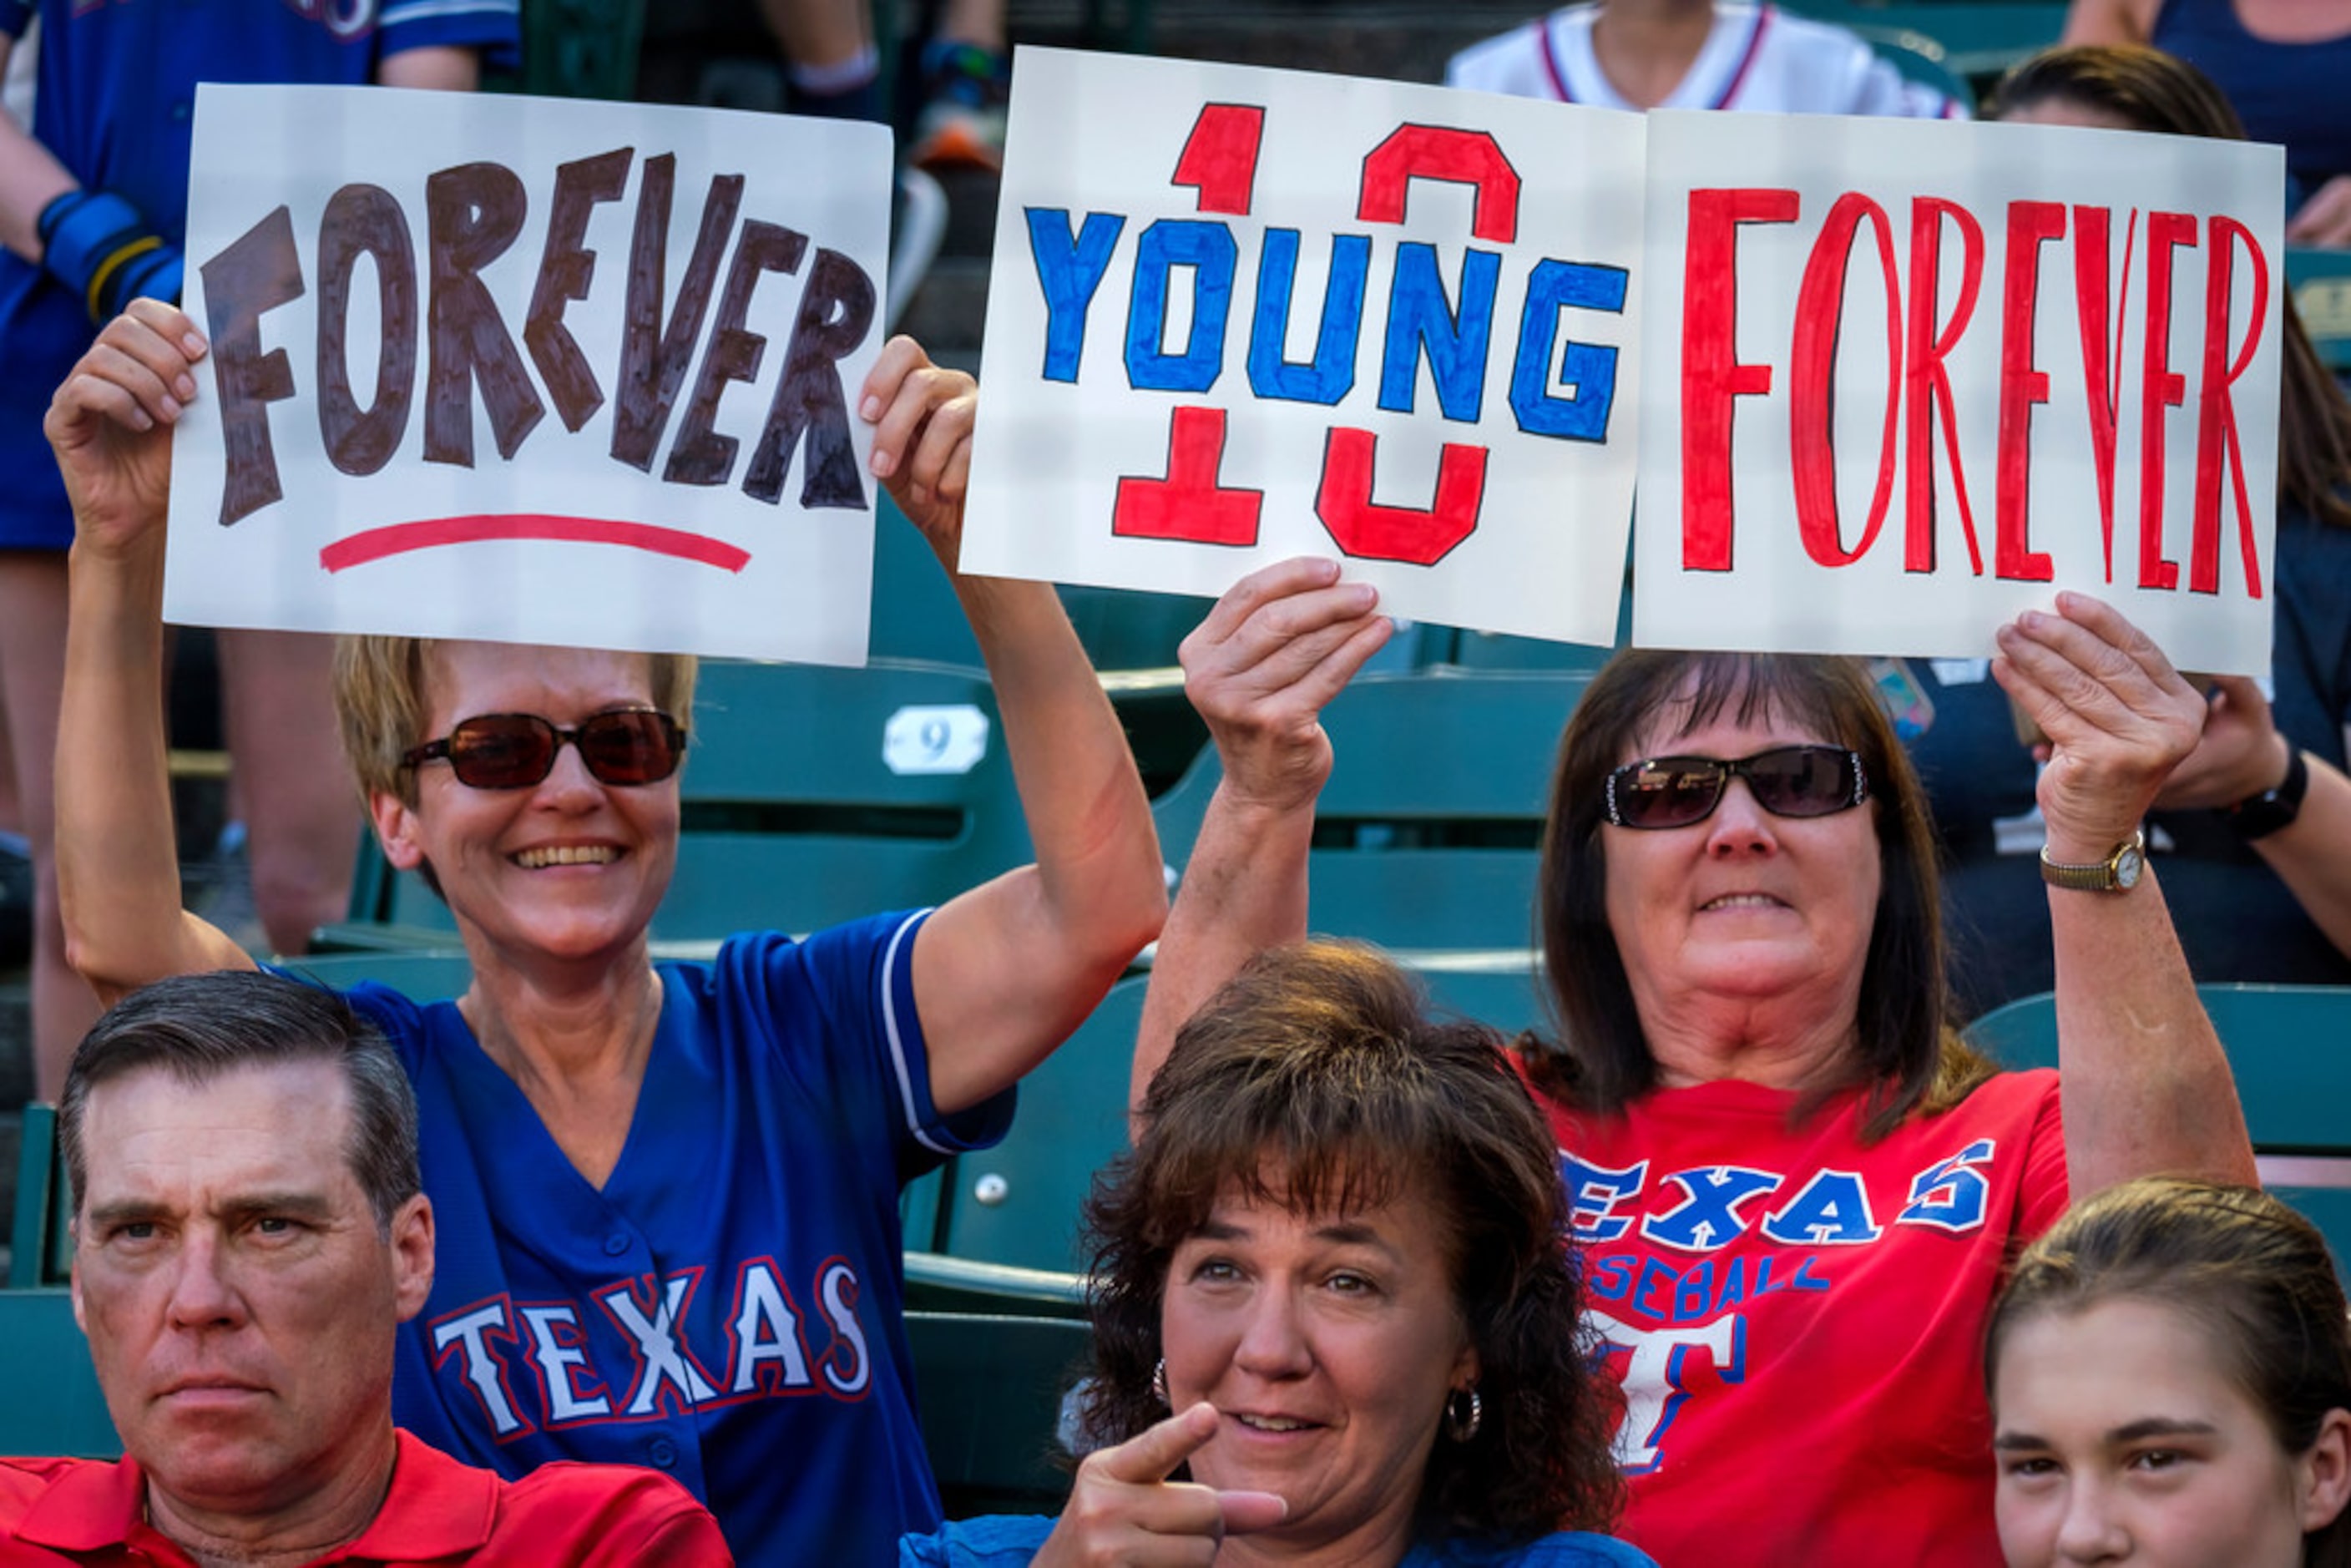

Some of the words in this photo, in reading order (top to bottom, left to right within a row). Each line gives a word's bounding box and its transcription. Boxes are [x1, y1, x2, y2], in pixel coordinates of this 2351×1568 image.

[200, 146, 876, 526] FOREVER
[1024, 207, 1629, 443] YOUNG
[1681, 189, 2266, 599] FOREVER
[920, 716, 951, 763] 9
[1558, 1138, 1996, 1252] EXAS
[430, 1255, 871, 1442] TEXAS
[1571, 1251, 1831, 1322] SEBALL
[1573, 1308, 1747, 1474] T
